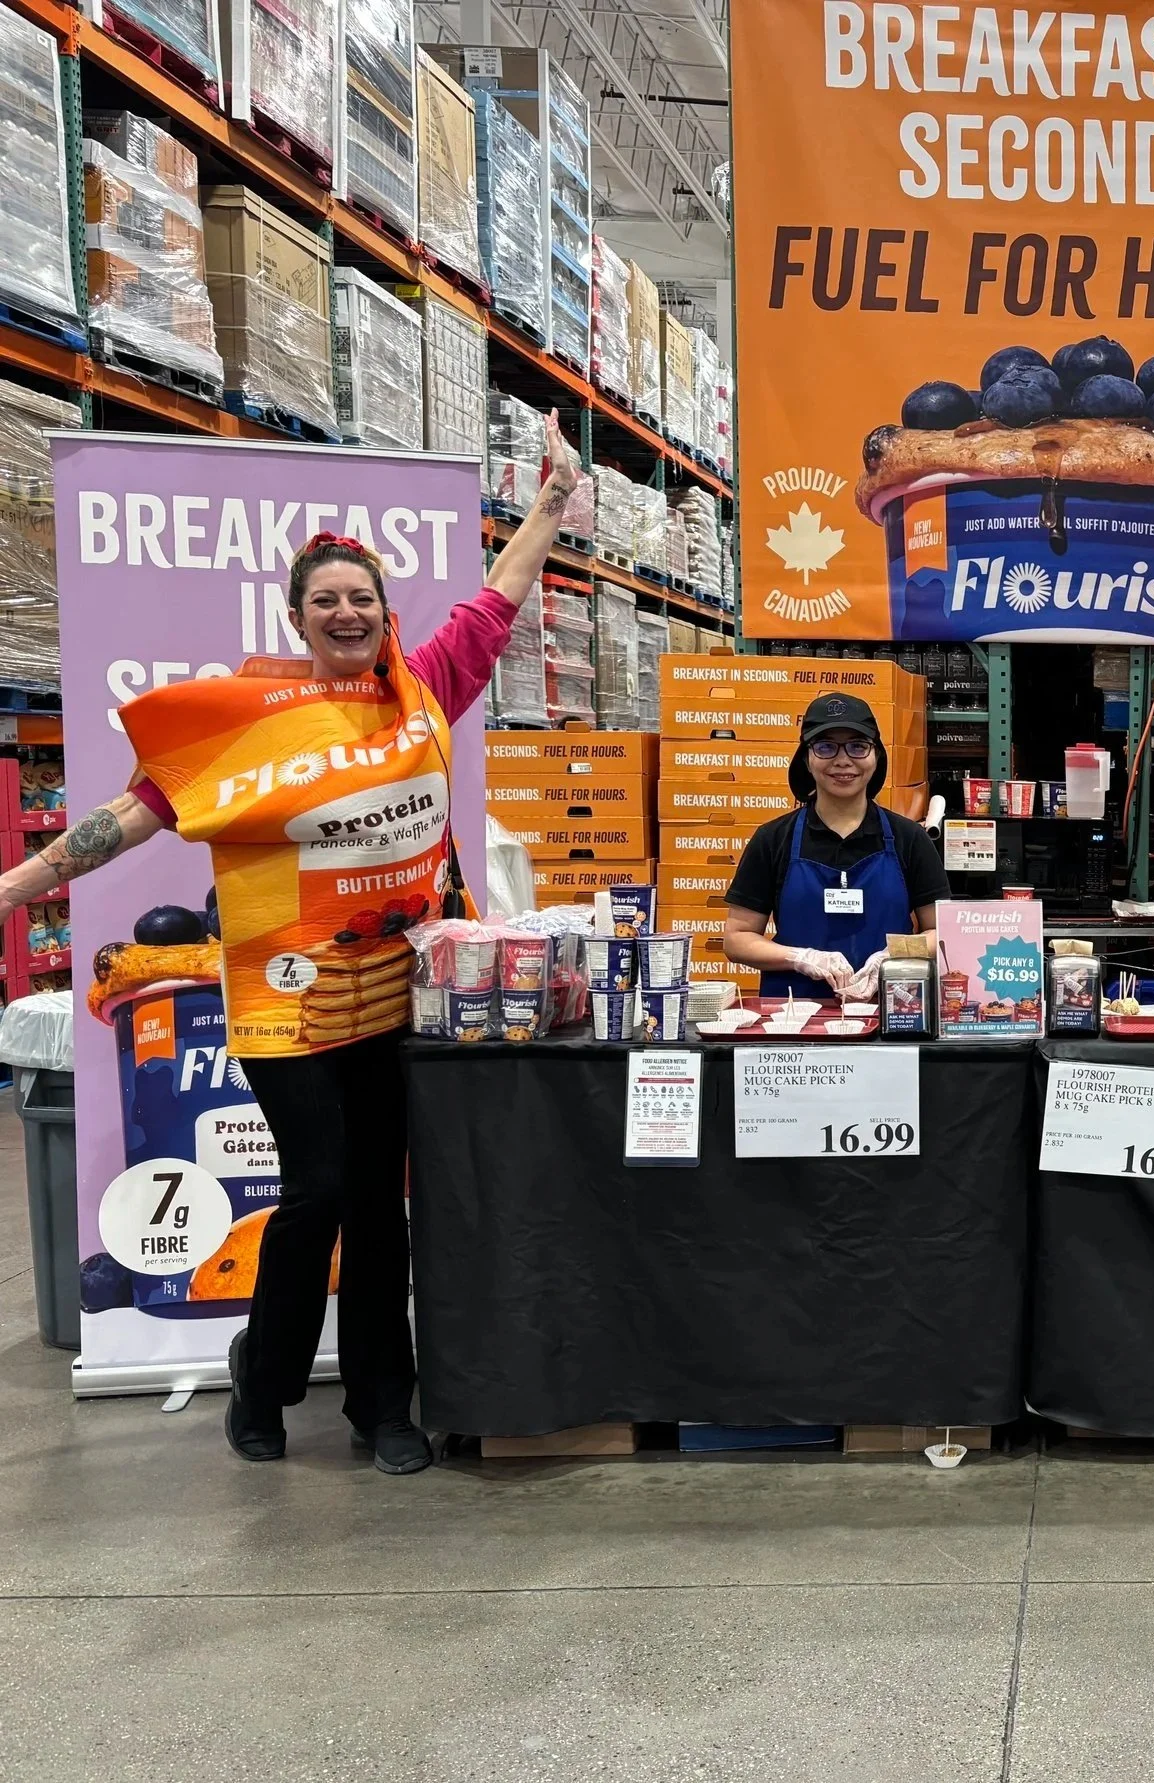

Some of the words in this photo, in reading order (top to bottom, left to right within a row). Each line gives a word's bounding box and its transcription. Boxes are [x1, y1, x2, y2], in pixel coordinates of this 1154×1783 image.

[768, 226, 939, 313] FUEL
[964, 232, 1097, 320] FOR
[763, 467, 848, 498] PROUDLY
[914, 519, 931, 532] NEW!
[964, 519, 985, 532] JUST
[987, 518, 1005, 530] ADD
[1008, 517, 1040, 530] WATER
[1064, 517, 1073, 529] IL
[1075, 518, 1109, 531] SUFFIT
[78, 491, 458, 581] BREAKFAST
[764, 588, 851, 623] CANADIAN
[673, 667, 727, 681] BREAKFAST
[730, 668, 741, 682] IN
[743, 669, 791, 683] SECONDS.
[793, 671, 817, 684] FUEL
[819, 671, 838, 684] FOR
[840, 672, 876, 686] HOURS.
[264, 688, 295, 705] JUST
[300, 683, 328, 696] ADD
[332, 681, 375, 694] WATER
[493, 745, 541, 758] SECONDS.
[544, 746, 568, 758] FUEL
[570, 746, 589, 758] FOR
[591, 746, 627, 758] HOURS.
[317, 793, 434, 838] Protein
[310, 836, 373, 849] Pancake
[379, 833, 389, 846] &
[393, 822, 429, 841] Waffle
[431, 812, 445, 828] Mix
[336, 856, 433, 895] BUTTERMILK
[956, 910, 1022, 924] Flourish
[961, 926, 985, 934] PROTEIN
[986, 926, 999, 934] MUG
[1000, 926, 1019, 934] CAKES
[281, 957, 296, 979] 7g
[993, 956, 1011, 966] PICK
[1012, 957, 1028, 967] ANY
[1028, 958, 1034, 967] 8
[987, 967, 1039, 983] $16.99
[143, 1017, 160, 1031] NEW!
[192, 1015, 211, 1027] JUST
[273, 1025, 296, 1038] (454g)
[757, 1053, 804, 1063] 1978007
[744, 1065, 801, 1075] FLOURISH
[805, 1064, 854, 1074] PROTEIN
[1071, 1068, 1115, 1081] 1978007
[744, 1076, 771, 1085] MUG
[775, 1076, 806, 1085] CAKE
[810, 1075, 836, 1085] PICK
[840, 1075, 846, 1084] 8
[1056, 1080, 1111, 1093] FLOURISH
[744, 1087, 750, 1096] 8
[762, 1086, 780, 1097] 75g
[1055, 1090, 1082, 1101] MUG
[1085, 1093, 1116, 1104] CAKE
[1118, 1096, 1143, 1106] PICK
[1146, 1098, 1153, 1106] 8
[1054, 1101, 1060, 1109] 8
[1072, 1102, 1089, 1113] 75g
[820, 1122, 915, 1153] 16.99
[1045, 1139, 1064, 1147] 2.832
[223, 1138, 277, 1154] Gâtea
[149, 1173, 190, 1229] 7g
[140, 1235, 189, 1255] FIBRE
[145, 1256, 158, 1267] per
[160, 1254, 188, 1265] serving
[163, 1281, 177, 1296] 75g
